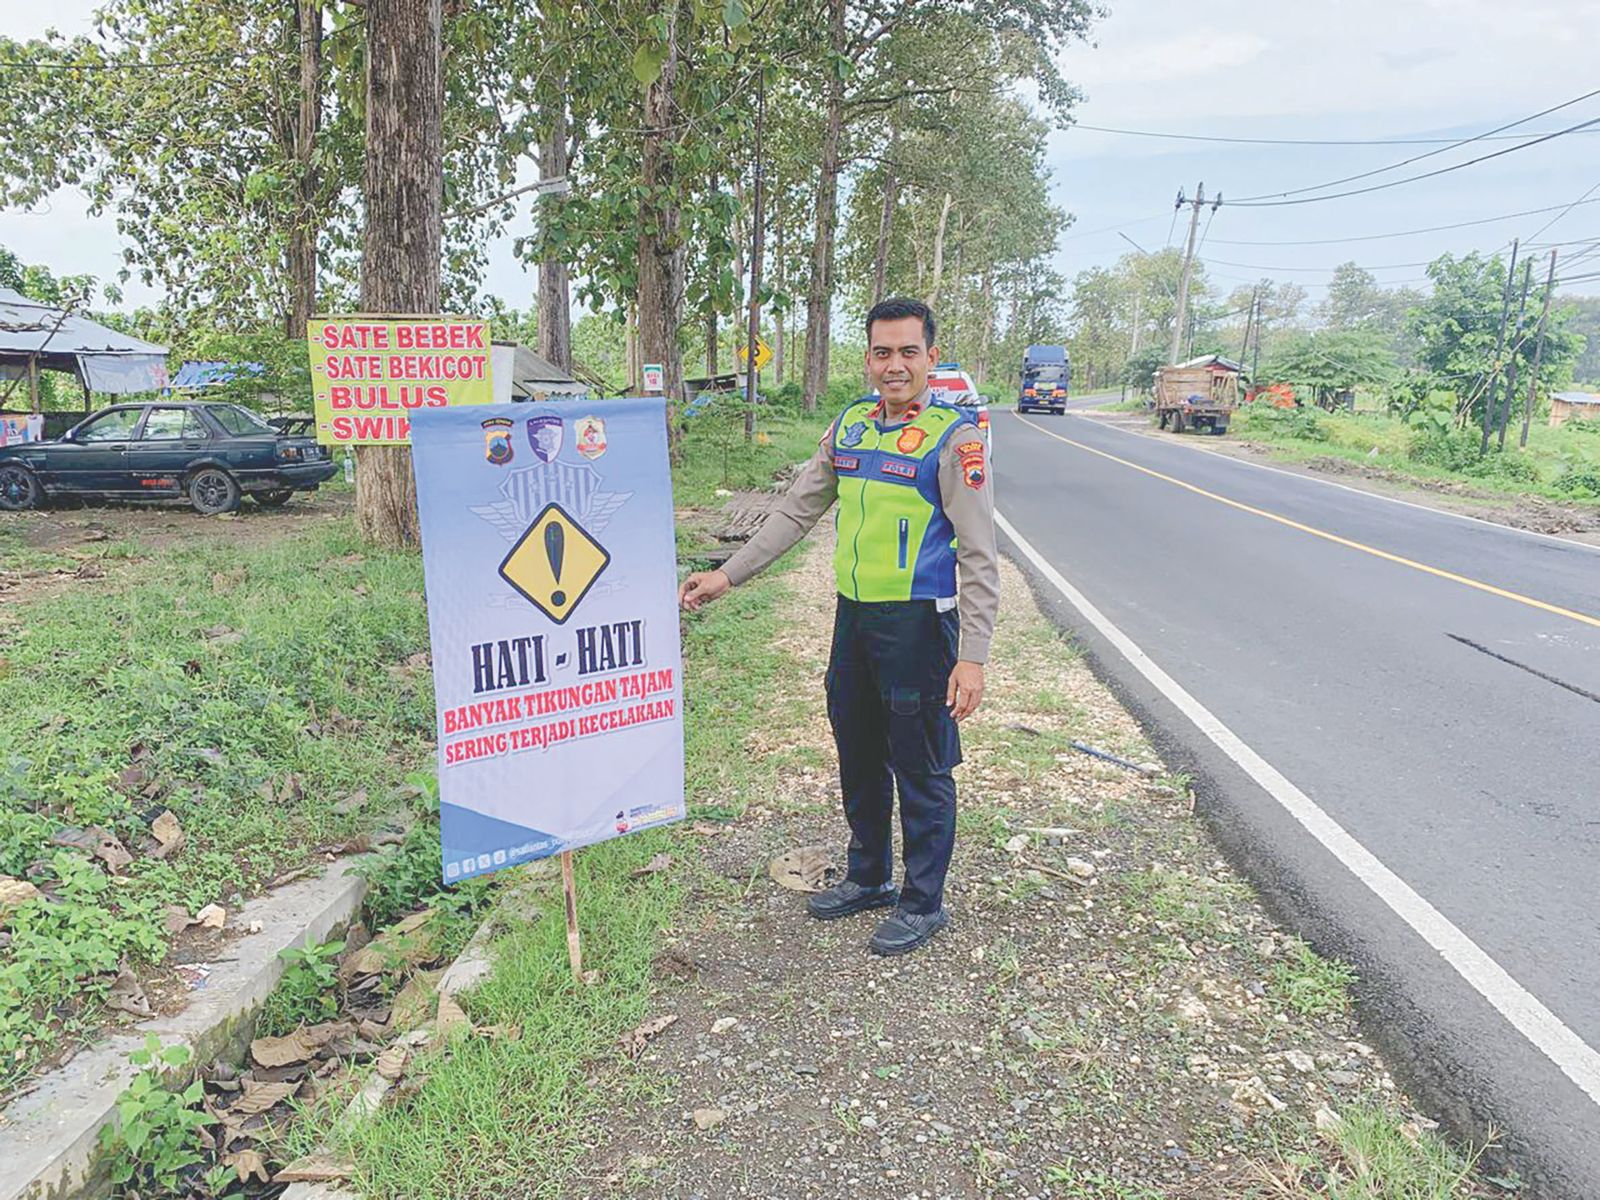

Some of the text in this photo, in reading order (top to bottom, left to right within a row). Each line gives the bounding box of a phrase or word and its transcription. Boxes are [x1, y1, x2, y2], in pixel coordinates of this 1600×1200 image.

[389, 356, 486, 379] BEKICOT
[396, 325, 485, 348] BEBEK
[471, 635, 546, 694] HATI
[576, 620, 642, 675] HATI
[444, 669, 673, 734] BANYAK TIKUNGAN TAJAM
[445, 699, 674, 764] SERING TERJADI KECELAKAAN
